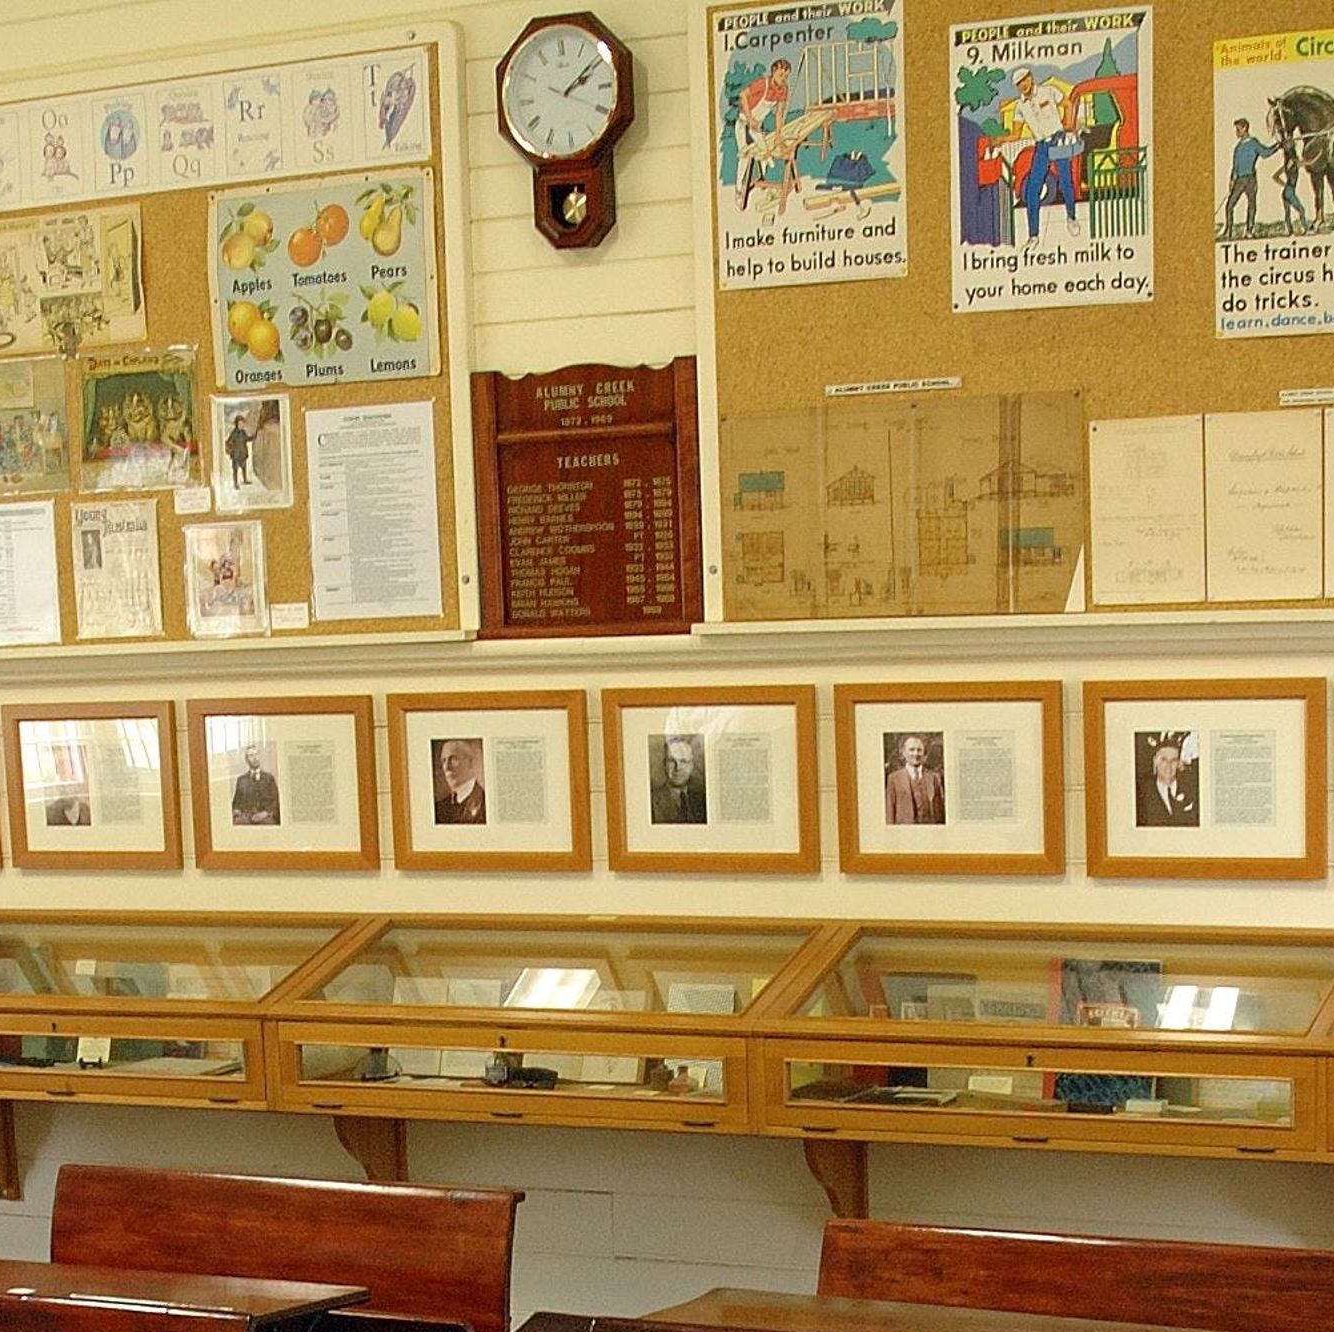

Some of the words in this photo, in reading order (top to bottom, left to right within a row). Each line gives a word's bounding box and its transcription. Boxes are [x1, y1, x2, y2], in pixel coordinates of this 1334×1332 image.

[723, 15, 769, 30] PEOPLE
[775, 12, 799, 23] and
[802, 5, 832, 20] their
[838, 0, 886, 16] WORK
[961, 26, 1011, 43] PEOPLE
[1016, 24, 1043, 37] and
[1046, 20, 1079, 35] their
[1083, 13, 1135, 31] WORK
[967, 46, 984, 66] 9.
[992, 40, 1083, 64] Milkman
[732, 228, 775, 249] make
[782, 224, 855, 245] furniture
[862, 217, 897, 238] and
[971, 250, 1018, 274] bring
[1023, 246, 1068, 268] fresh
[1074, 242, 1112, 264] milk
[1117, 244, 1135, 261] to
[1220, 244, 1259, 265] The
[1264, 240, 1332, 262] trainer
[370, 264, 408, 281] Pears
[726, 258, 764, 281] help
[768, 258, 785, 274] to
[790, 250, 836, 272] build
[842, 249, 908, 268] houses.
[232, 277, 273, 296] Apples
[291, 270, 348, 288] Tomatoes
[965, 285, 1005, 306] your
[1011, 277, 1058, 297] home
[1064, 273, 1105, 292] each
[1110, 271, 1149, 295] day.
[1221, 269, 1253, 289] the
[1258, 266, 1316, 286] circus
[1222, 292, 1248, 313] do
[1255, 289, 1320, 311] tricks.
[305, 363, 345, 378] Plums
[370, 357, 417, 373] Lemons
[235, 369, 283, 385] Oranges
[595, 379, 635, 394] CREEK
[543, 398, 581, 412] PUBLIC
[587, 394, 628, 409] SCHOOL
[556, 452, 620, 469] TEACHERS
